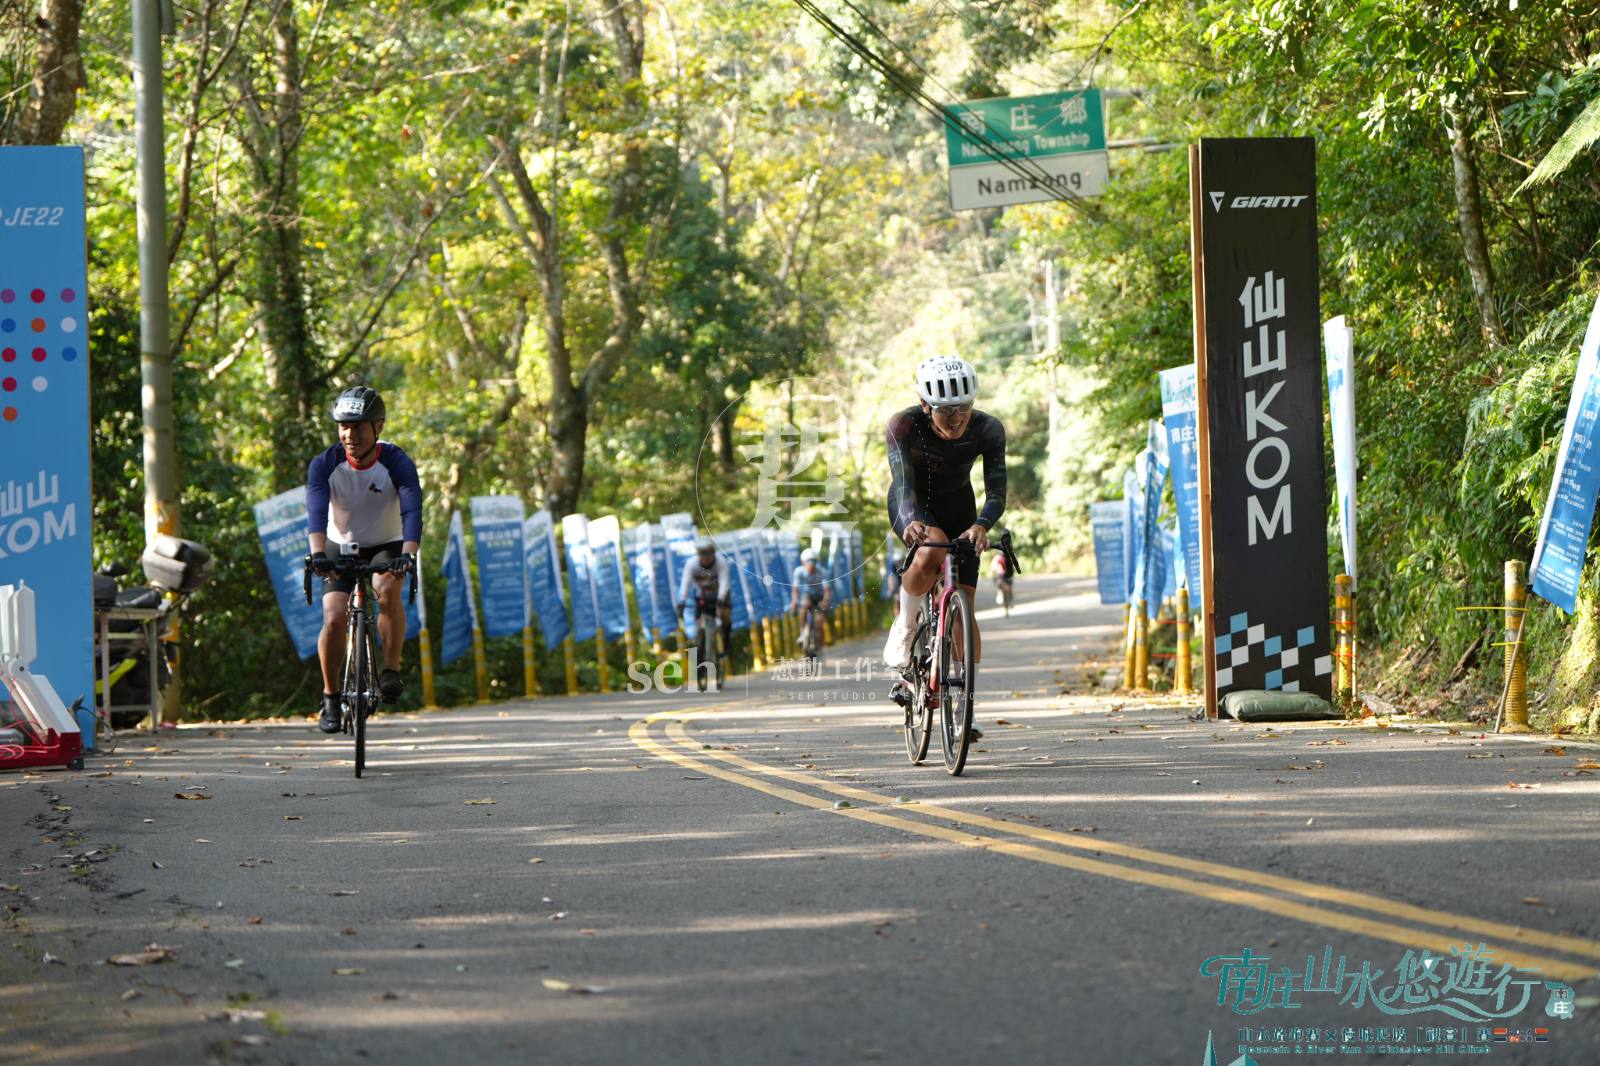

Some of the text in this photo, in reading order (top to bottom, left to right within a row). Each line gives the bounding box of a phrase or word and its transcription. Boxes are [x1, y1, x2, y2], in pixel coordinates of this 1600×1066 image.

[1034, 130, 1091, 150] Township
[978, 171, 1082, 196] Namzong
[1230, 195, 1310, 209] GIANT
